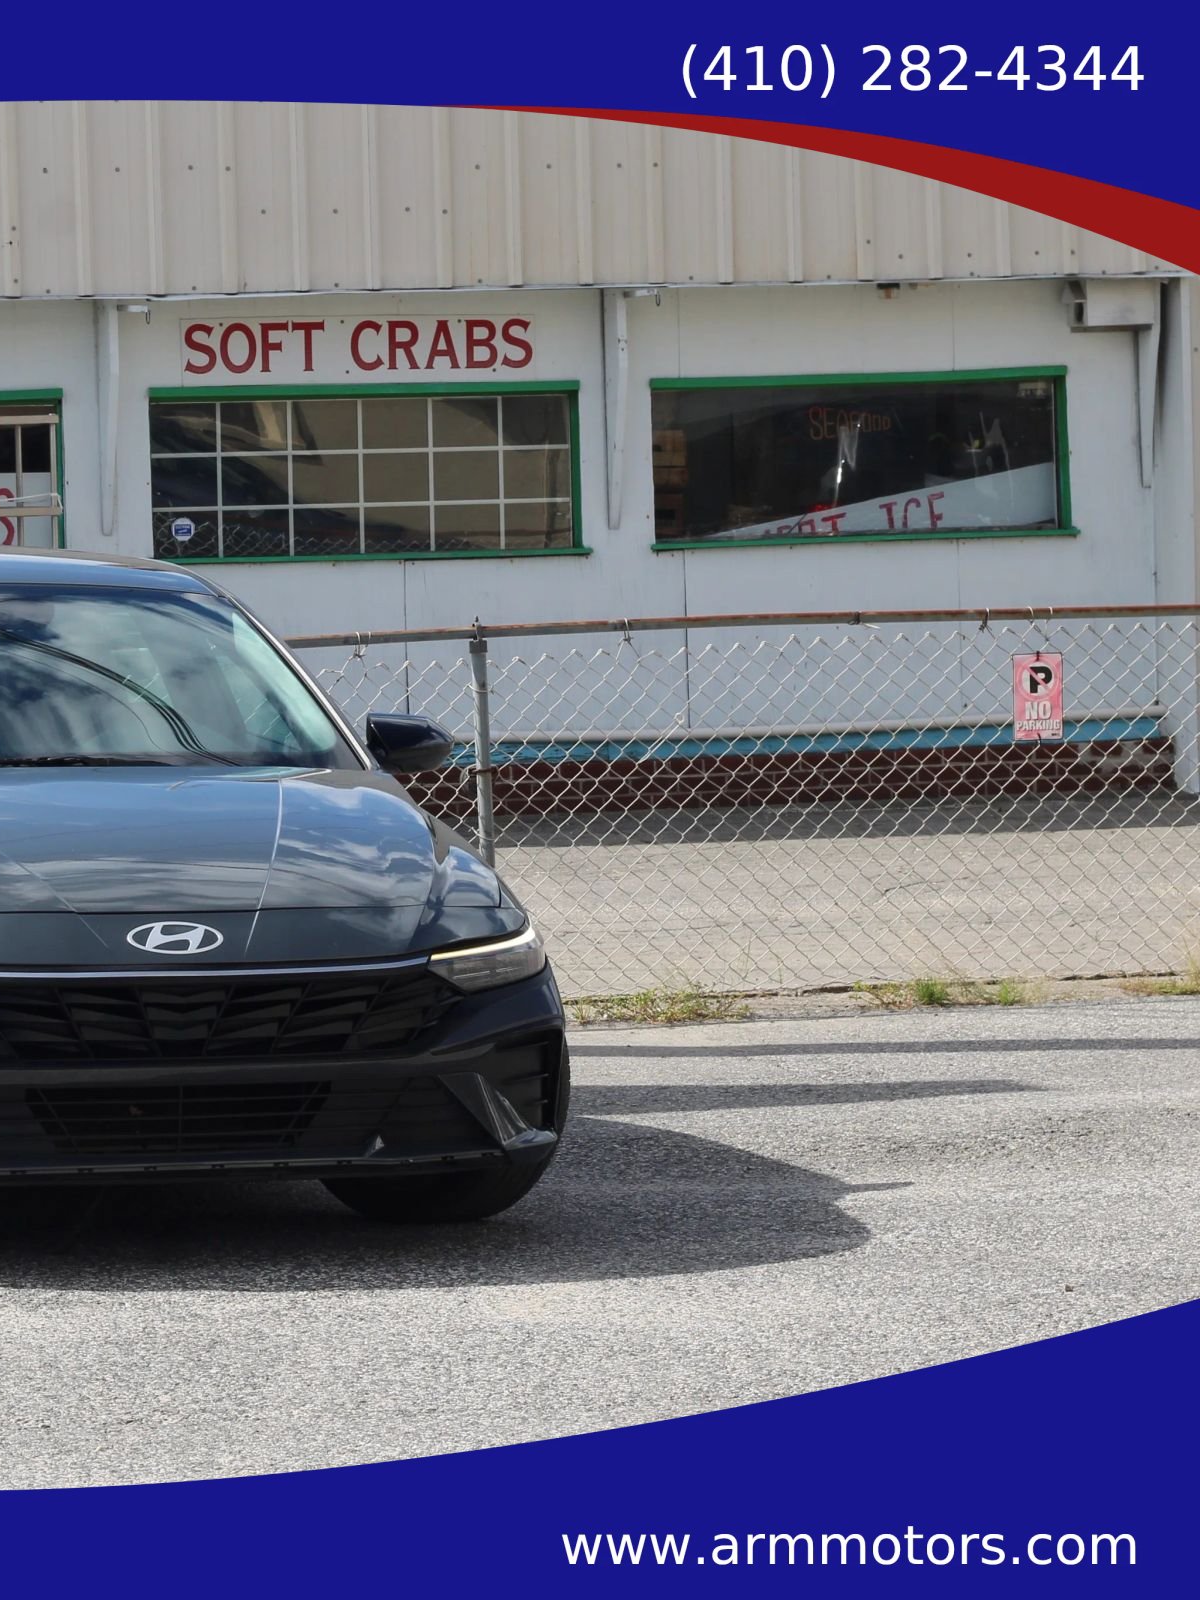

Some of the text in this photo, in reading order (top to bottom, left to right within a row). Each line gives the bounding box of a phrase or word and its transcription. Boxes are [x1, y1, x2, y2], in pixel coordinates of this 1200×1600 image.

[184, 317, 534, 374] SOFT CRABS
[1025, 700, 1052, 720] NO
[1015, 719, 1061, 732] PARKING
